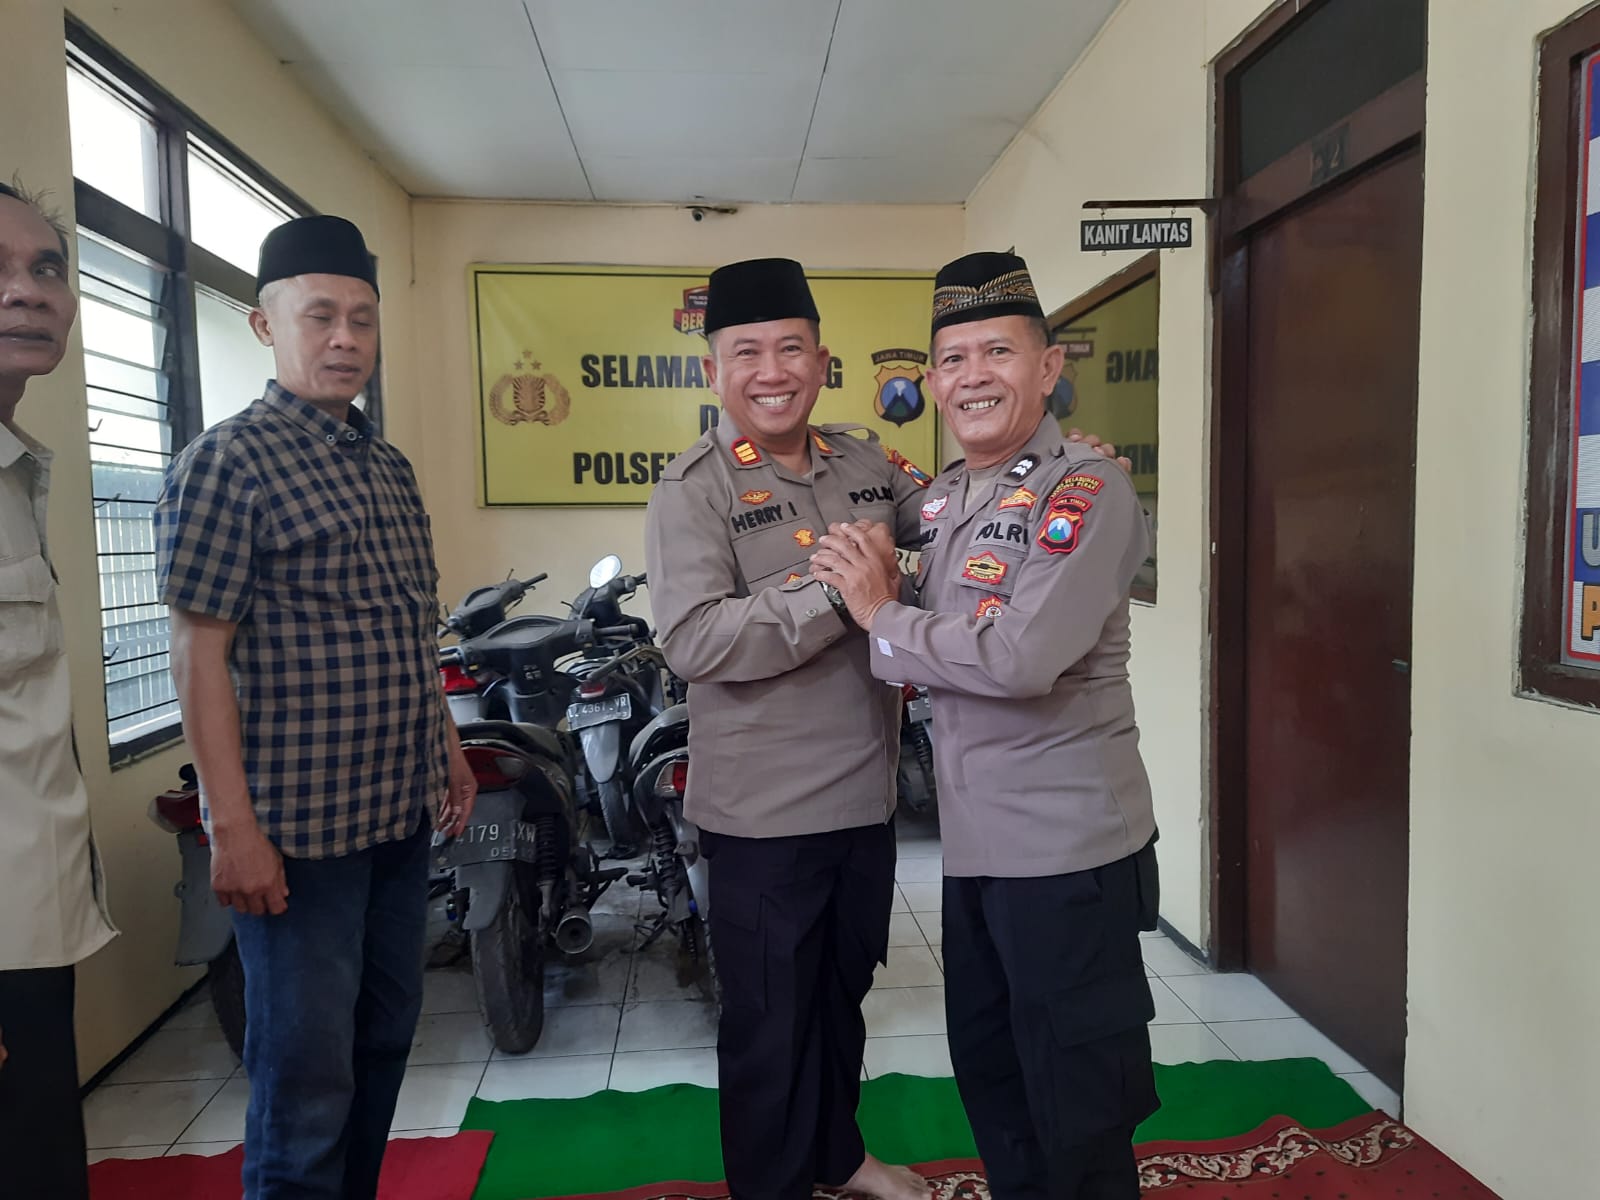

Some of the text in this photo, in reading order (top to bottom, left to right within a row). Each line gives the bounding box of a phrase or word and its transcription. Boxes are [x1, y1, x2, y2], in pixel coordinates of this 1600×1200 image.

[1084, 222, 1188, 245] KANIT LANTAS
[581, 354, 710, 388] SELAMA
[573, 452, 682, 485] POLSE
[731, 501, 797, 533] HERRY I
[455, 823, 500, 844] 179
